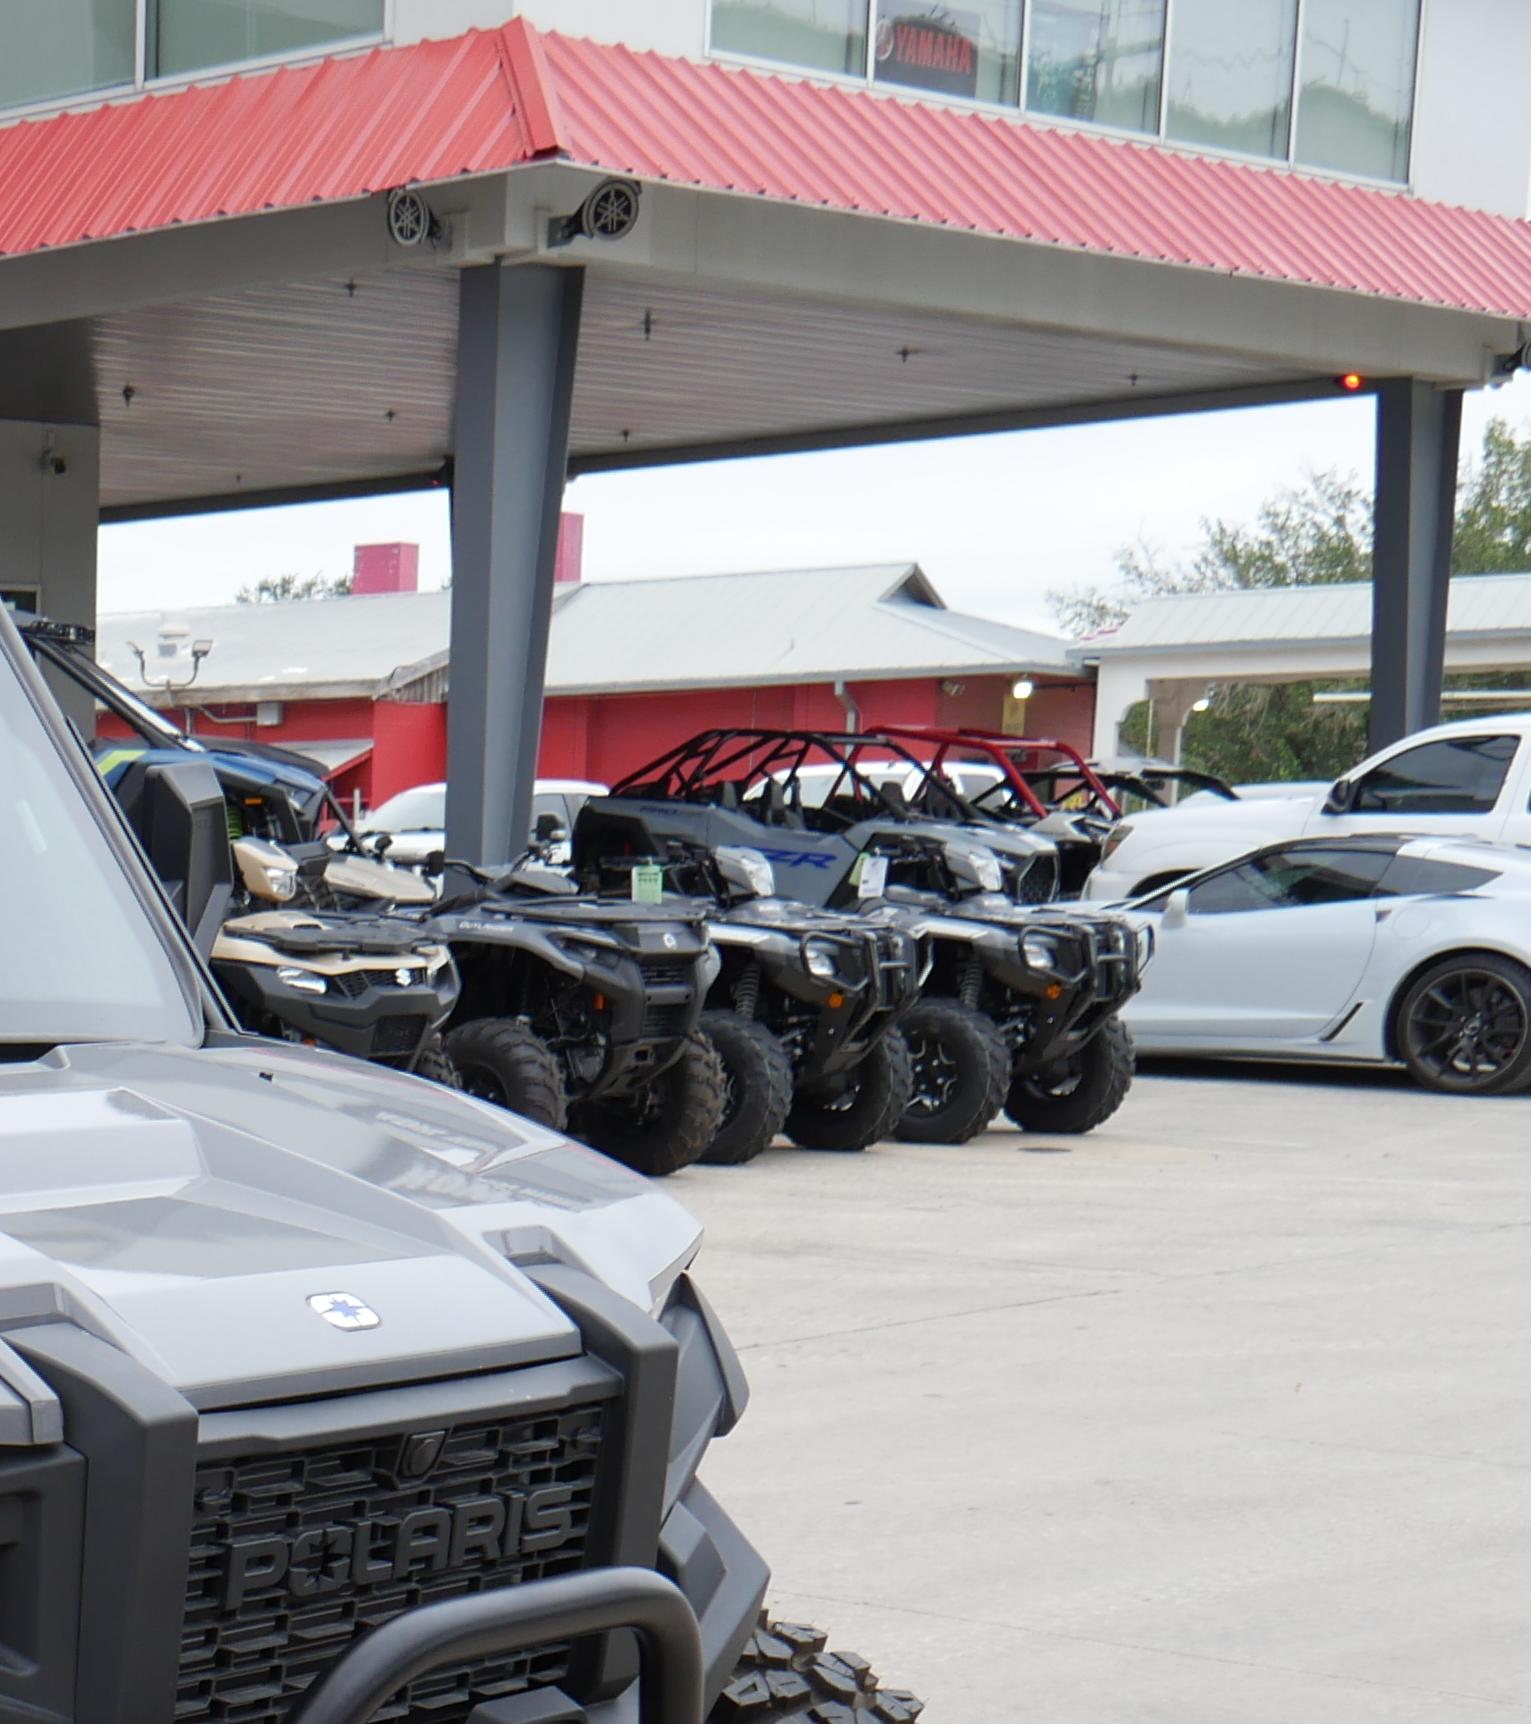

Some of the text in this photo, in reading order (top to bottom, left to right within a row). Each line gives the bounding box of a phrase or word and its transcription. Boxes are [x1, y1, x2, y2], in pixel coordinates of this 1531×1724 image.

[895, 23, 971, 75] YAMAHA
[732, 845, 838, 870] ZR
[223, 1481, 573, 1612] POLARIS
